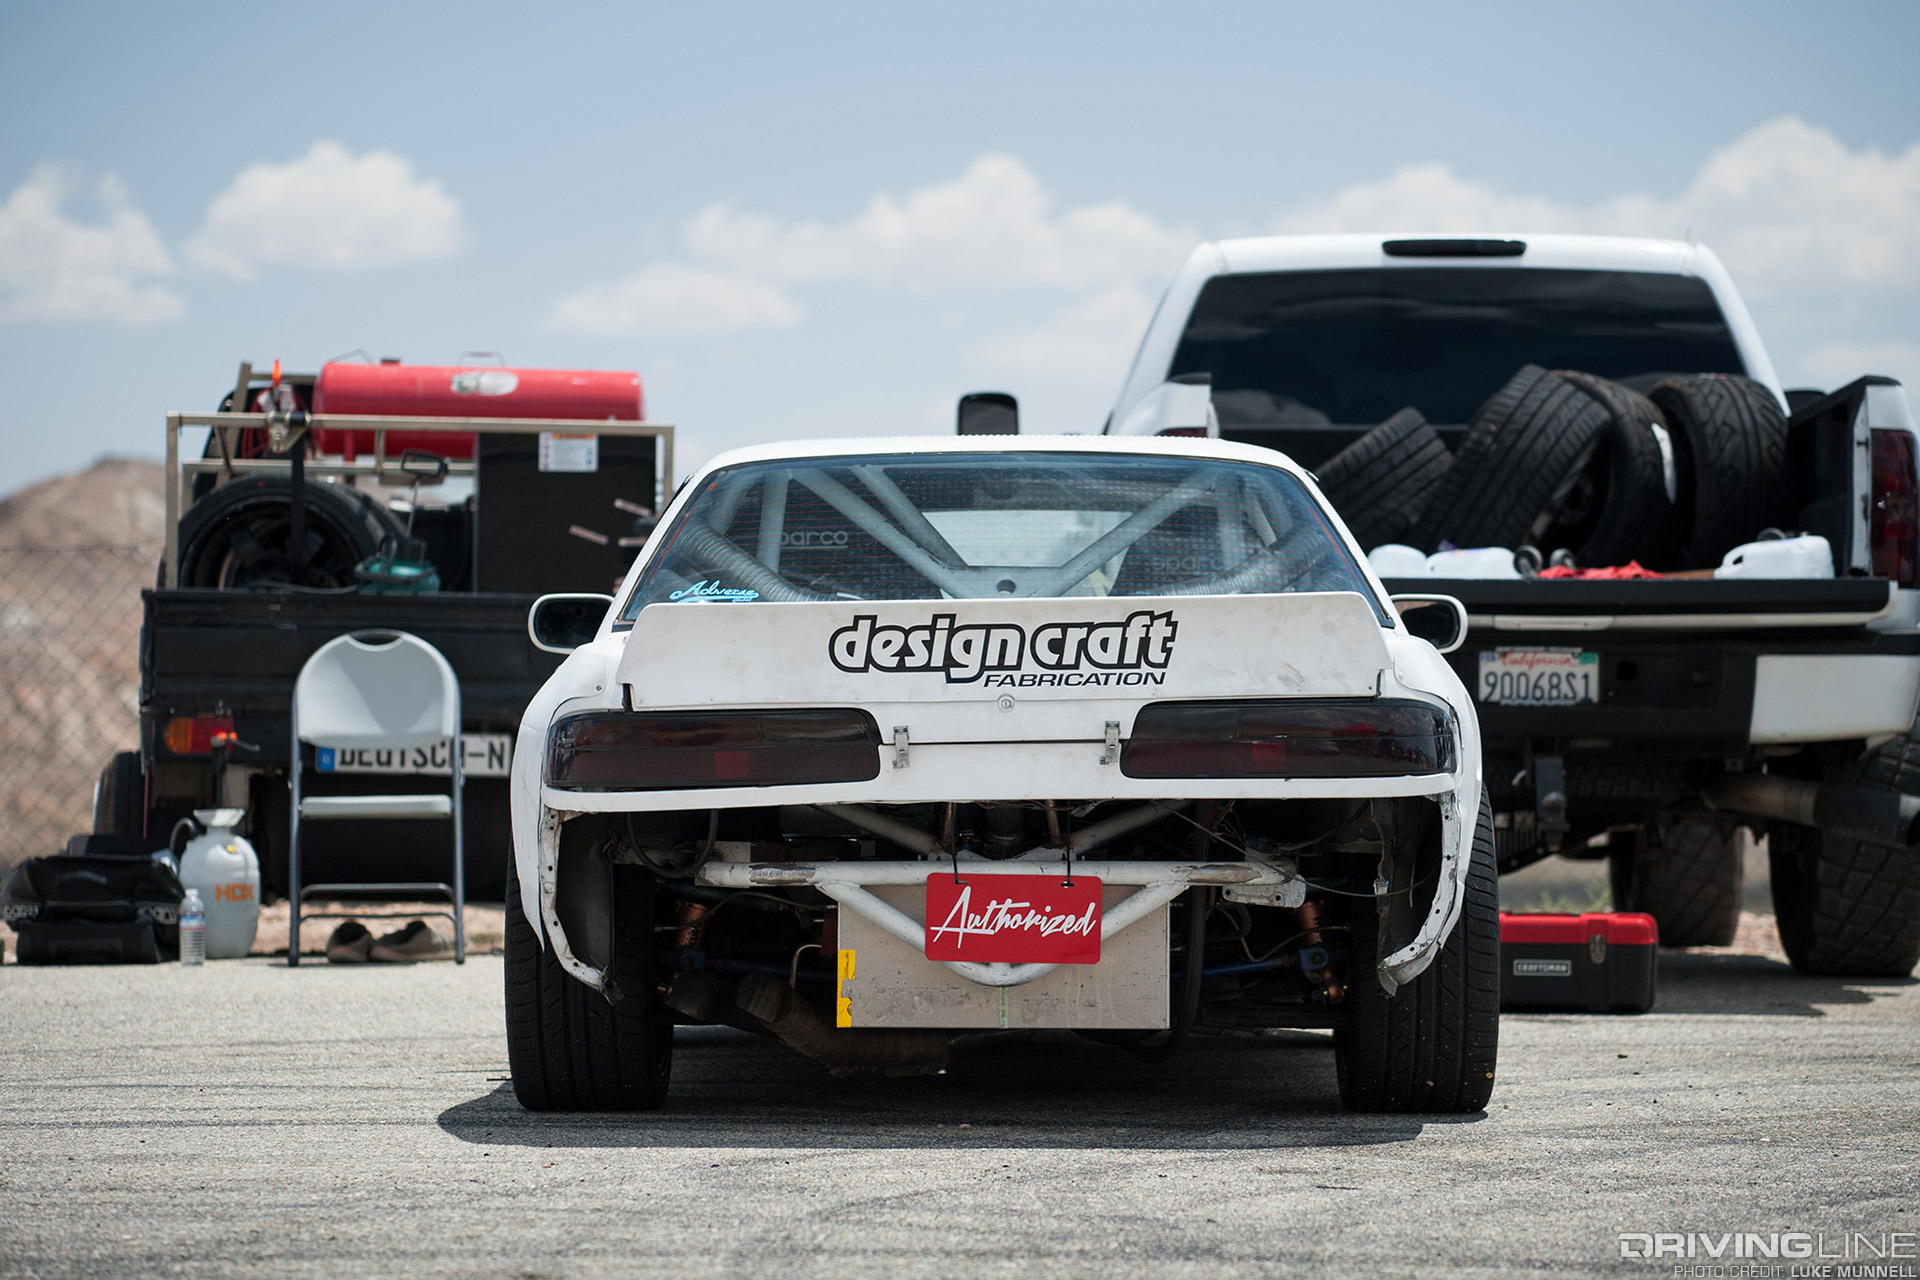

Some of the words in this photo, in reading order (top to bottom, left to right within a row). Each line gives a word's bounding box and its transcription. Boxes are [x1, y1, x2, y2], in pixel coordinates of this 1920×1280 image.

[781, 531, 849, 546] parco
[1152, 556, 1224, 576] sparc
[669, 579, 759, 600] Adverse
[828, 613, 1026, 684] design
[1030, 610, 1179, 671] craft
[983, 672, 1167, 688] FABRICATION
[1484, 671, 1591, 701] 90068S1
[215, 883, 255, 903] HDX
[930, 886, 1097, 949] Authorized
